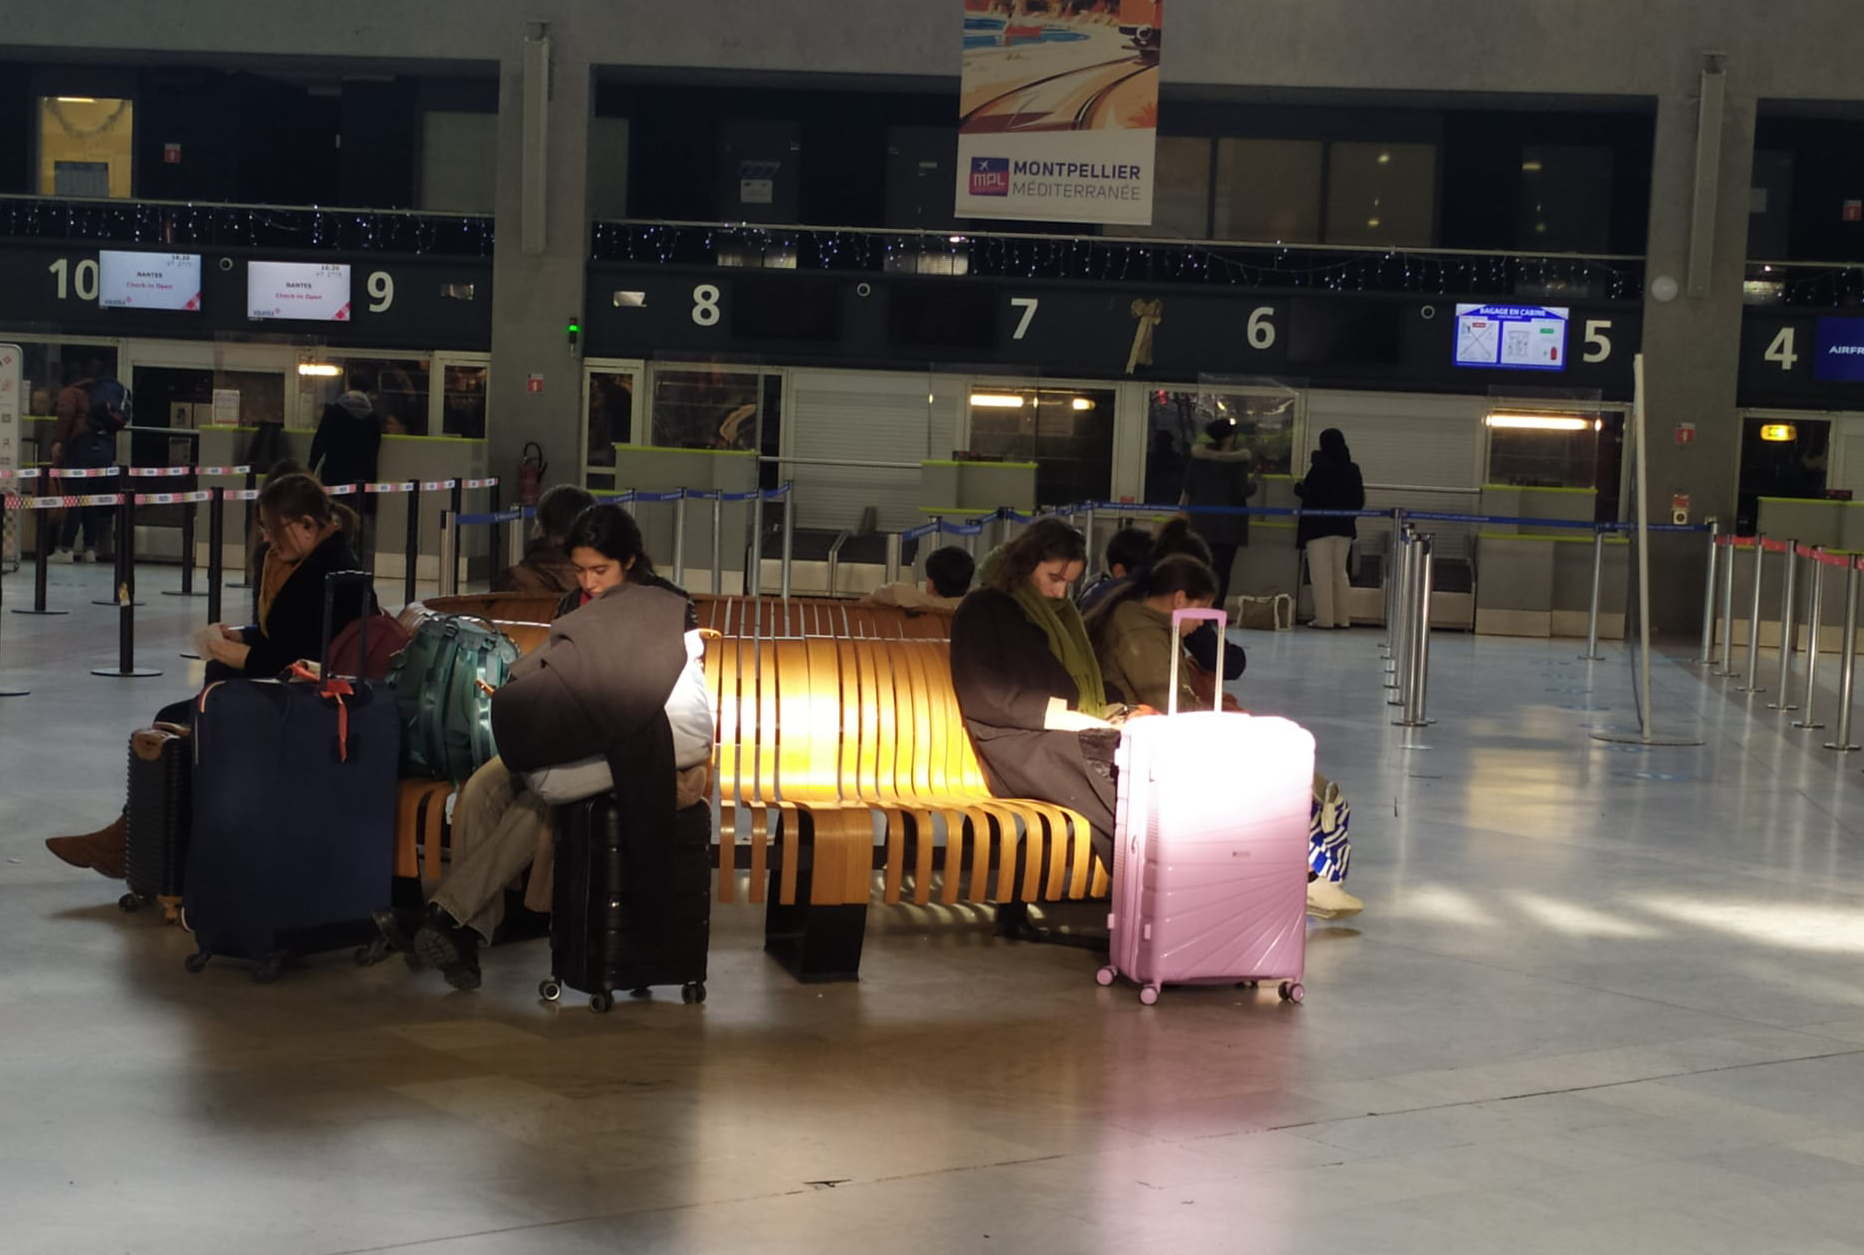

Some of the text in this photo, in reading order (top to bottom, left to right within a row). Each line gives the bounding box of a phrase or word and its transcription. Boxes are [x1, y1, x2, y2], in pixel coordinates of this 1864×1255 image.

[1013, 160, 1141, 180] MONTPELLIER
[1012, 180, 1141, 201] MÉDITERRANÉE
[48, 259, 99, 300] 10
[127, 281, 173, 291] Check-in Open
[137, 271, 163, 279] NANTES
[286, 282, 312, 290] NANTES
[305, 293, 322, 301] Open
[367, 271, 394, 313] 9
[692, 284, 720, 326] 8
[1011, 298, 1039, 340] 7
[1480, 307, 1508, 315] BAGAGE
[1509, 308, 1519, 316] EN
[1520, 309, 1546, 317] CABINE
[1247, 306, 1276, 350] 6
[1583, 320, 1612, 363] 5
[1764, 326, 1798, 370] 4
